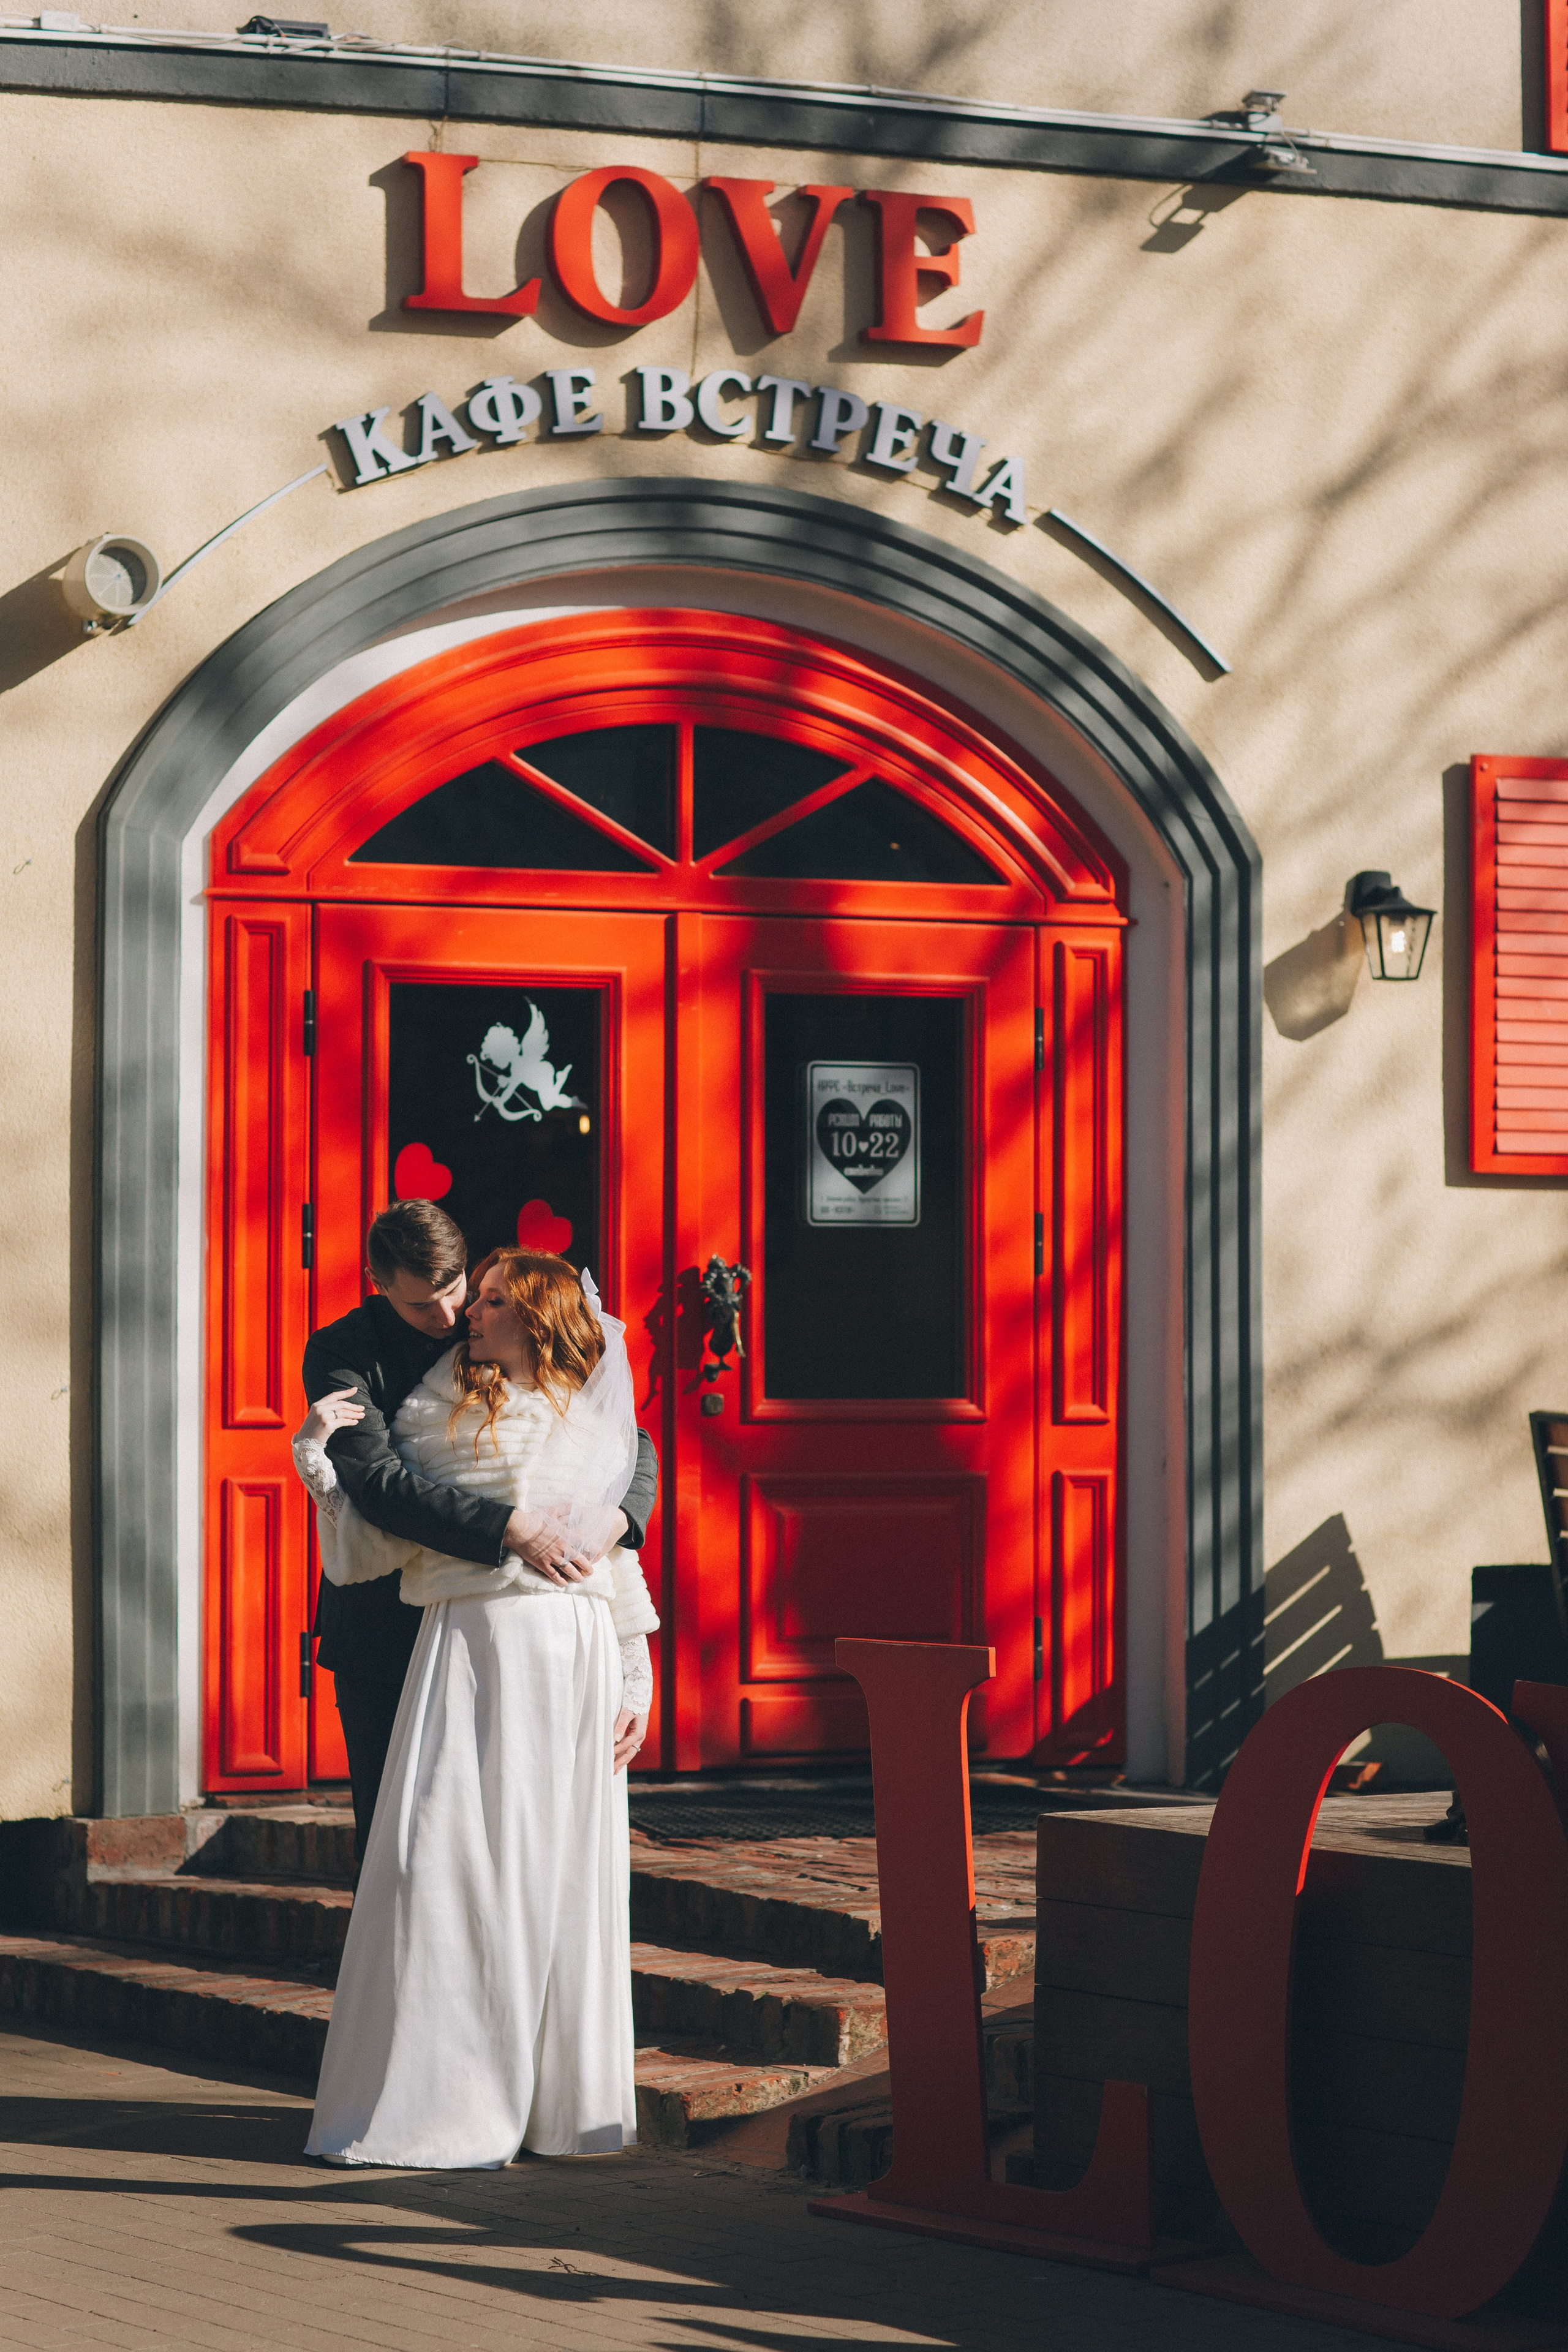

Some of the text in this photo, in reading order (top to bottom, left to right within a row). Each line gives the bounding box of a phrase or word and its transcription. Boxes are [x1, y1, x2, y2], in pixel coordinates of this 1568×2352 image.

[401, 150, 986, 350] LOVE
[334, 365, 1030, 526] КАФЕ ВСТРЕЧА
[831, 1131, 899, 1158] 10 22
[834, 1637, 1568, 2323] LO
